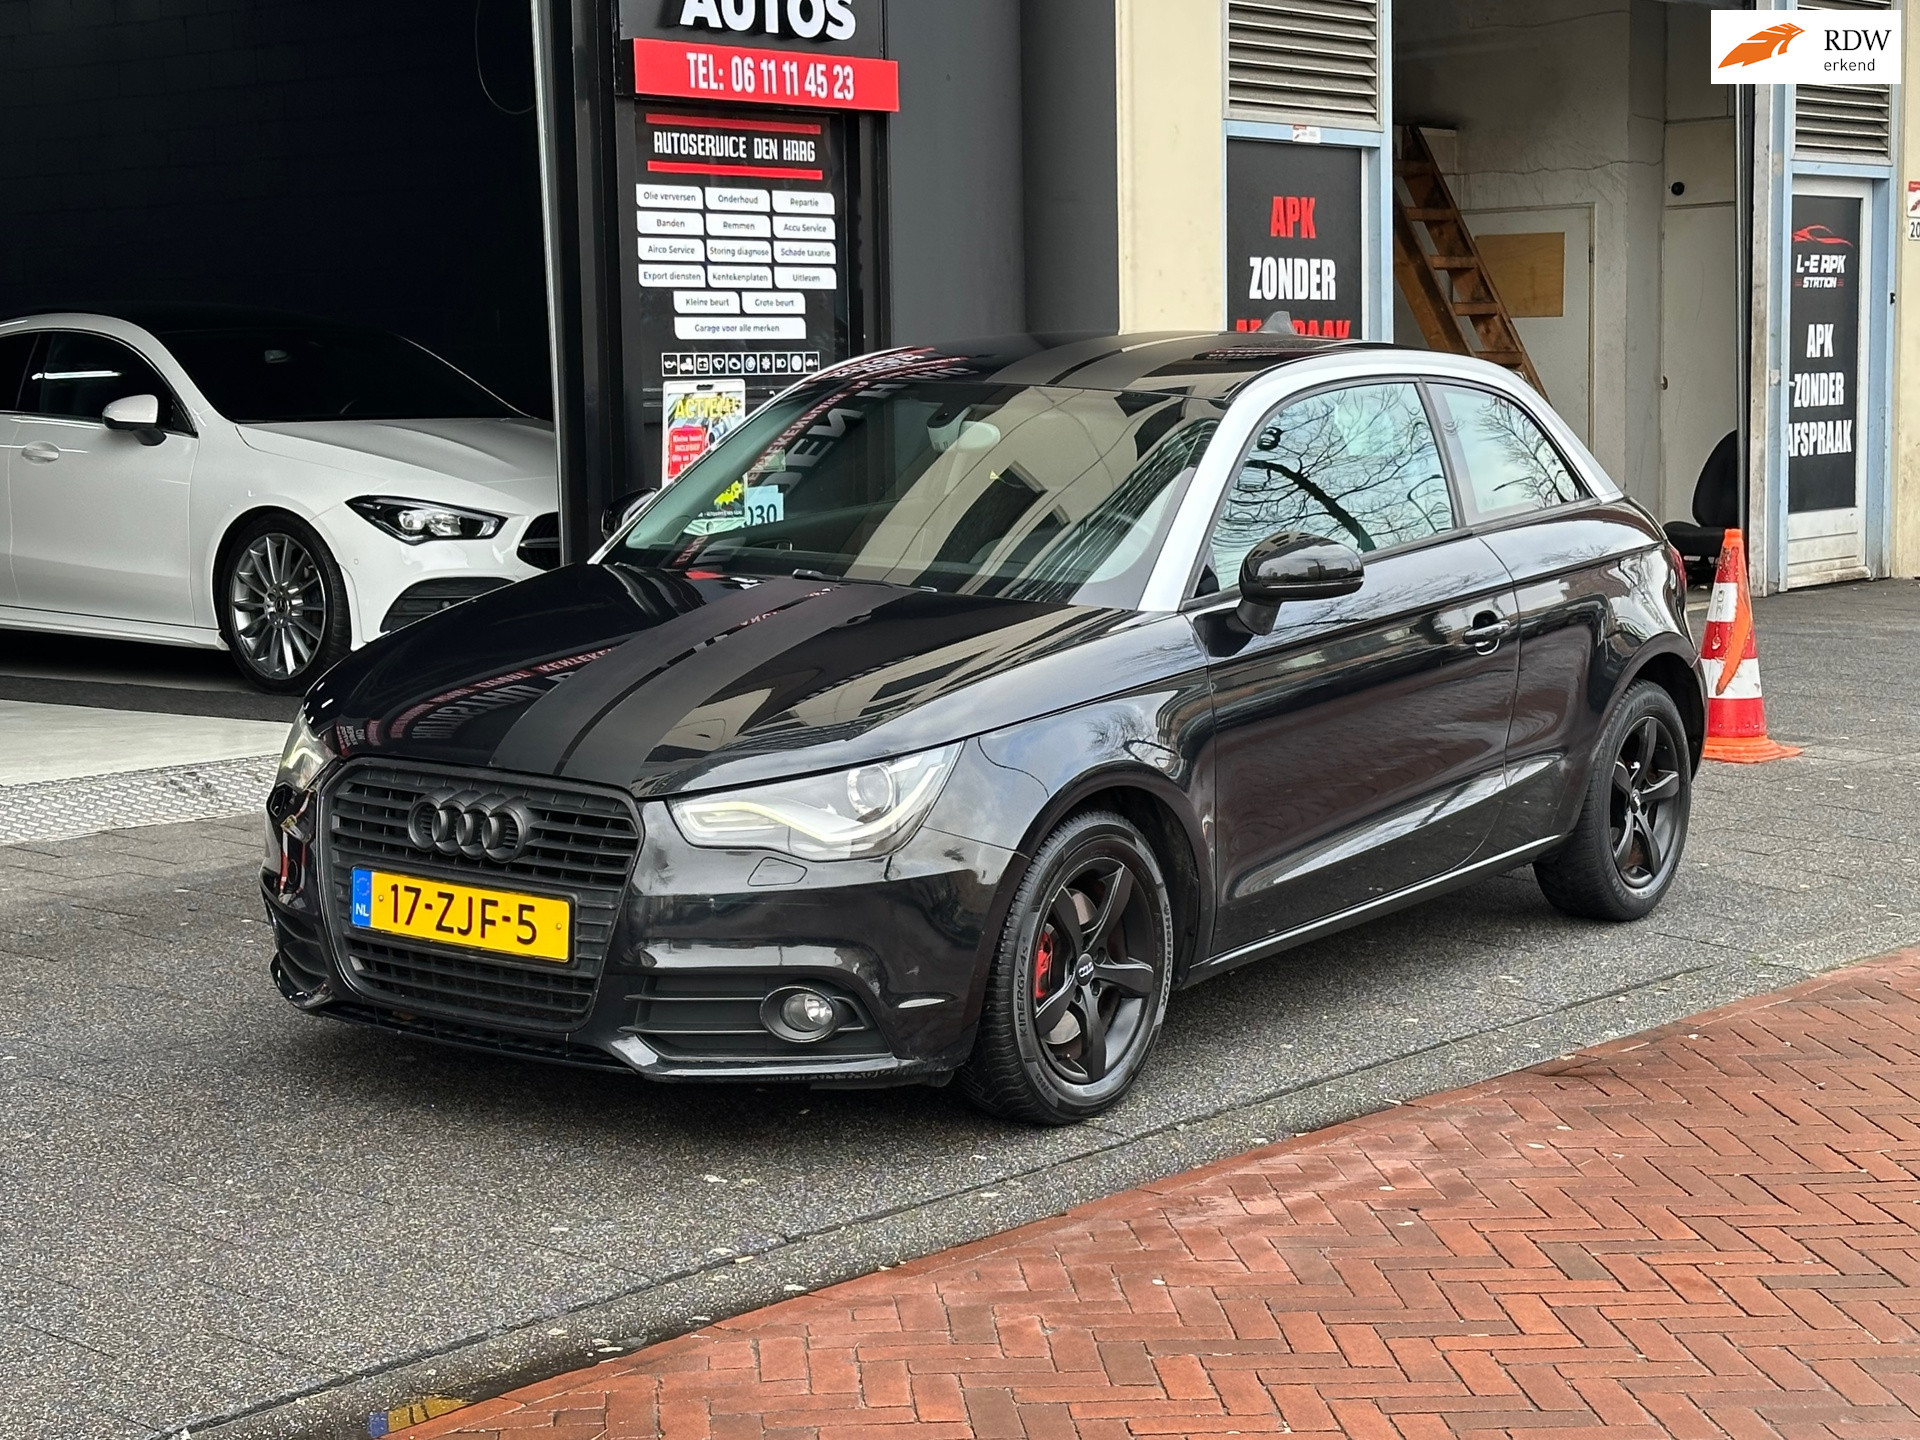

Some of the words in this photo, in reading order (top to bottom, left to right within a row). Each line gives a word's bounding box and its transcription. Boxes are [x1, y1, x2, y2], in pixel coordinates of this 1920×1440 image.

[686, 52, 725, 91] TEL:
[731, 55, 756, 93] 06
[760, 58, 777, 95] 11
[782, 60, 799, 96] 11
[804, 63, 828, 99] 45
[832, 64, 855, 101] 23
[653, 131, 747, 159] AUTOSERVICE
[753, 137, 779, 161] DEN
[782, 139, 816, 162] HAAG
[643, 191, 659, 201] Olie
[660, 193, 696, 202] verversen
[717, 194, 759, 205] Onderhoud
[789, 197, 819, 208] Repartie
[1269, 195, 1317, 239] APK
[656, 218, 686, 228] Banden
[722, 220, 756, 230] Remmen
[783, 223, 801, 232] Accu
[802, 223, 827, 233] Service
[647, 244, 667, 254] Airco
[668, 244, 695, 255] Service
[709, 246, 736, 258] Storing
[736, 246, 770, 258] diagnose
[780, 247, 806, 257] Schade
[806, 248, 831, 258] taxatie
[1820, 254, 1847, 274] APK
[643, 271, 668, 282] Export
[669, 271, 701, 281] diensten
[712, 273, 769, 283] Kentekenplaten
[792, 274, 821, 282] Uitlezen
[1248, 256, 1336, 301] ZONDER
[1802, 276, 1838, 289] STATION
[685, 298, 708, 306] Kleine
[710, 298, 730, 307] beurt
[754, 298, 774, 307] Grote
[775, 298, 795, 307] beurt
[694, 323, 721, 334] Garage
[721, 325, 738, 333] voor
[739, 323, 752, 333] alle
[752, 323, 780, 333] merken
[1806, 323, 1834, 359] APK
[1793, 371, 1845, 408] ZONDER
[1789, 419, 1853, 457] AFSPRAAK
[355, 902, 370, 917] NL
[390, 883, 538, 945] 17-ZJF-5
